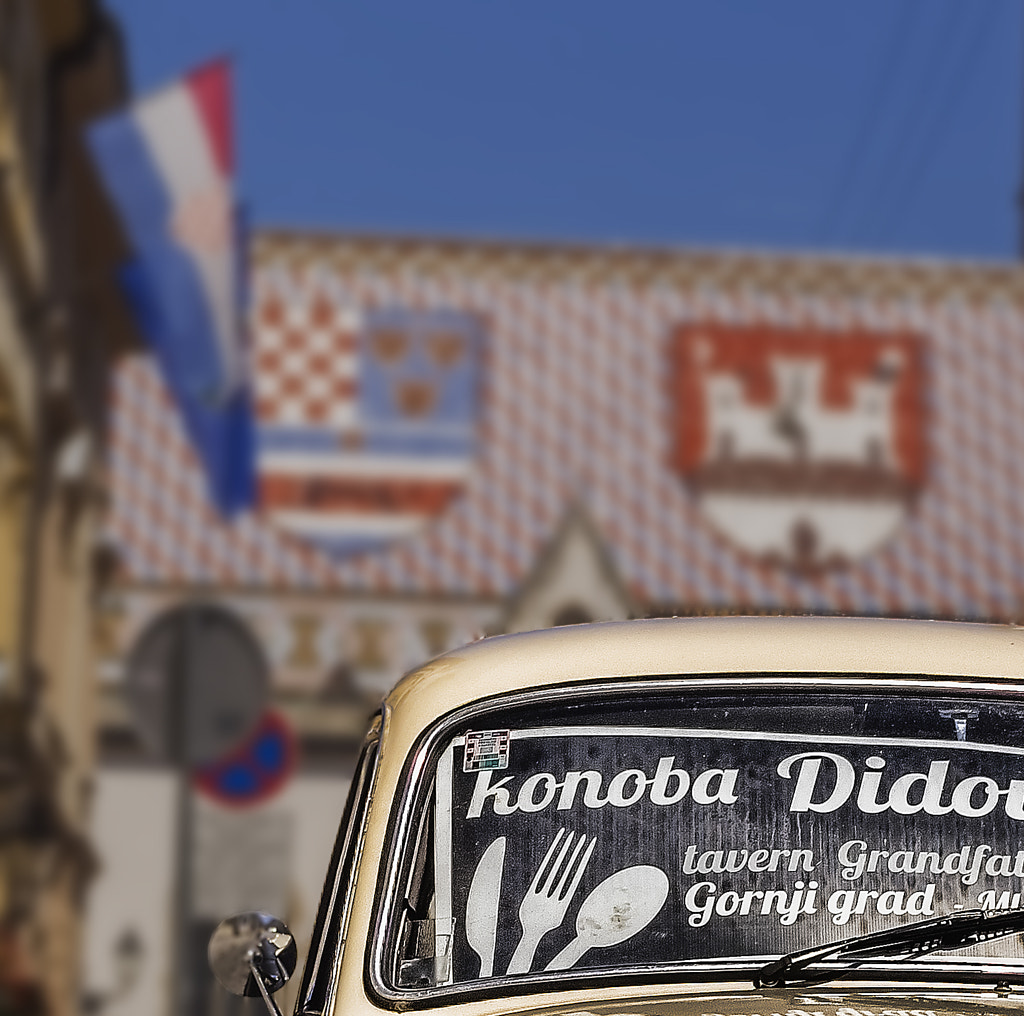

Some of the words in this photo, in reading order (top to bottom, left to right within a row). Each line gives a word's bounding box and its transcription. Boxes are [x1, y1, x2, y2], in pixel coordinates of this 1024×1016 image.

[465, 755, 740, 820] konoba
[682, 843, 815, 876] tavern
[684, 880, 817, 928] Gornji
[827, 880, 936, 926] grad
